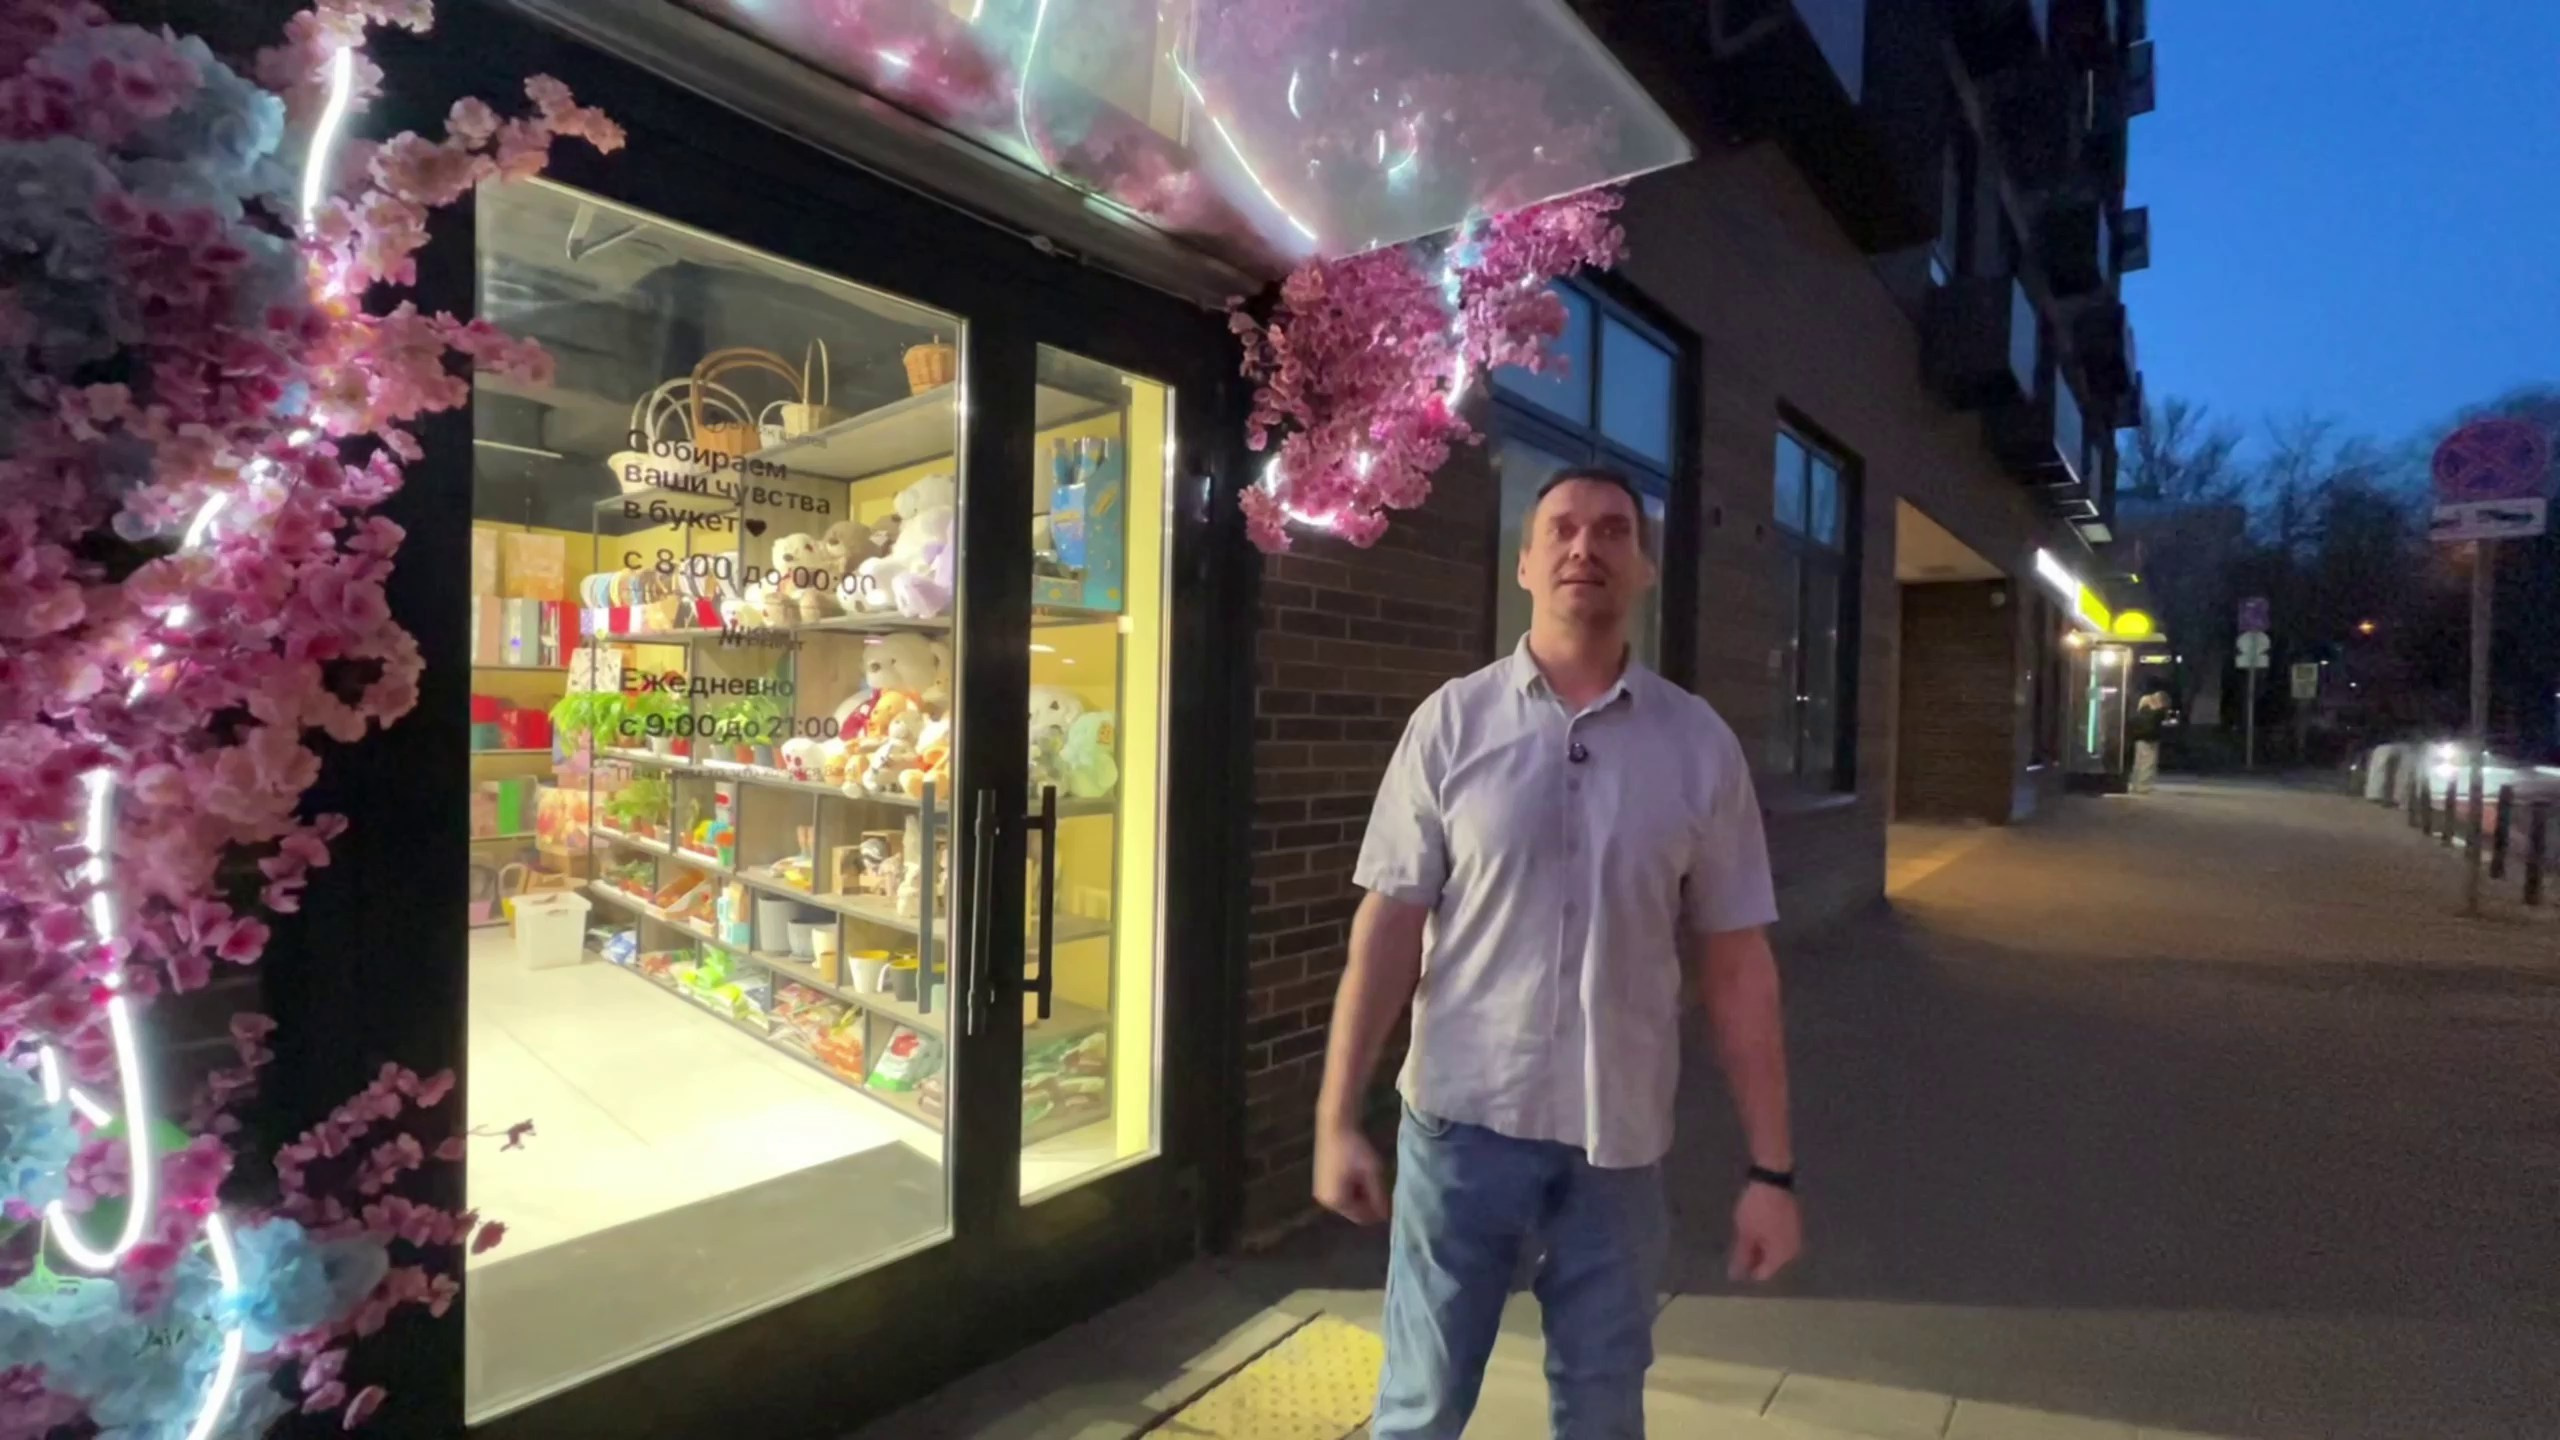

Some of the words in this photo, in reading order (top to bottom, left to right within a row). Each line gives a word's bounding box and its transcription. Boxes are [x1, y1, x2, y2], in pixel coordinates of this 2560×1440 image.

[628, 430, 787, 480] Собираем
[625, 464, 708, 492] ваши
[716, 479, 831, 514] чувства
[624, 501, 641, 519] в
[650, 500, 738, 533] букет
[624, 551, 642, 570] с
[656, 548, 732, 580] 8:00
[743, 566, 780, 589] до
[794, 566, 876, 596] 00:00
[621, 667, 794, 698] Ежедневно
[619, 717, 636, 736] с
[646, 713, 716, 737] 9:00
[721, 720, 760, 742] до
[767, 716, 839, 738] 21:00
